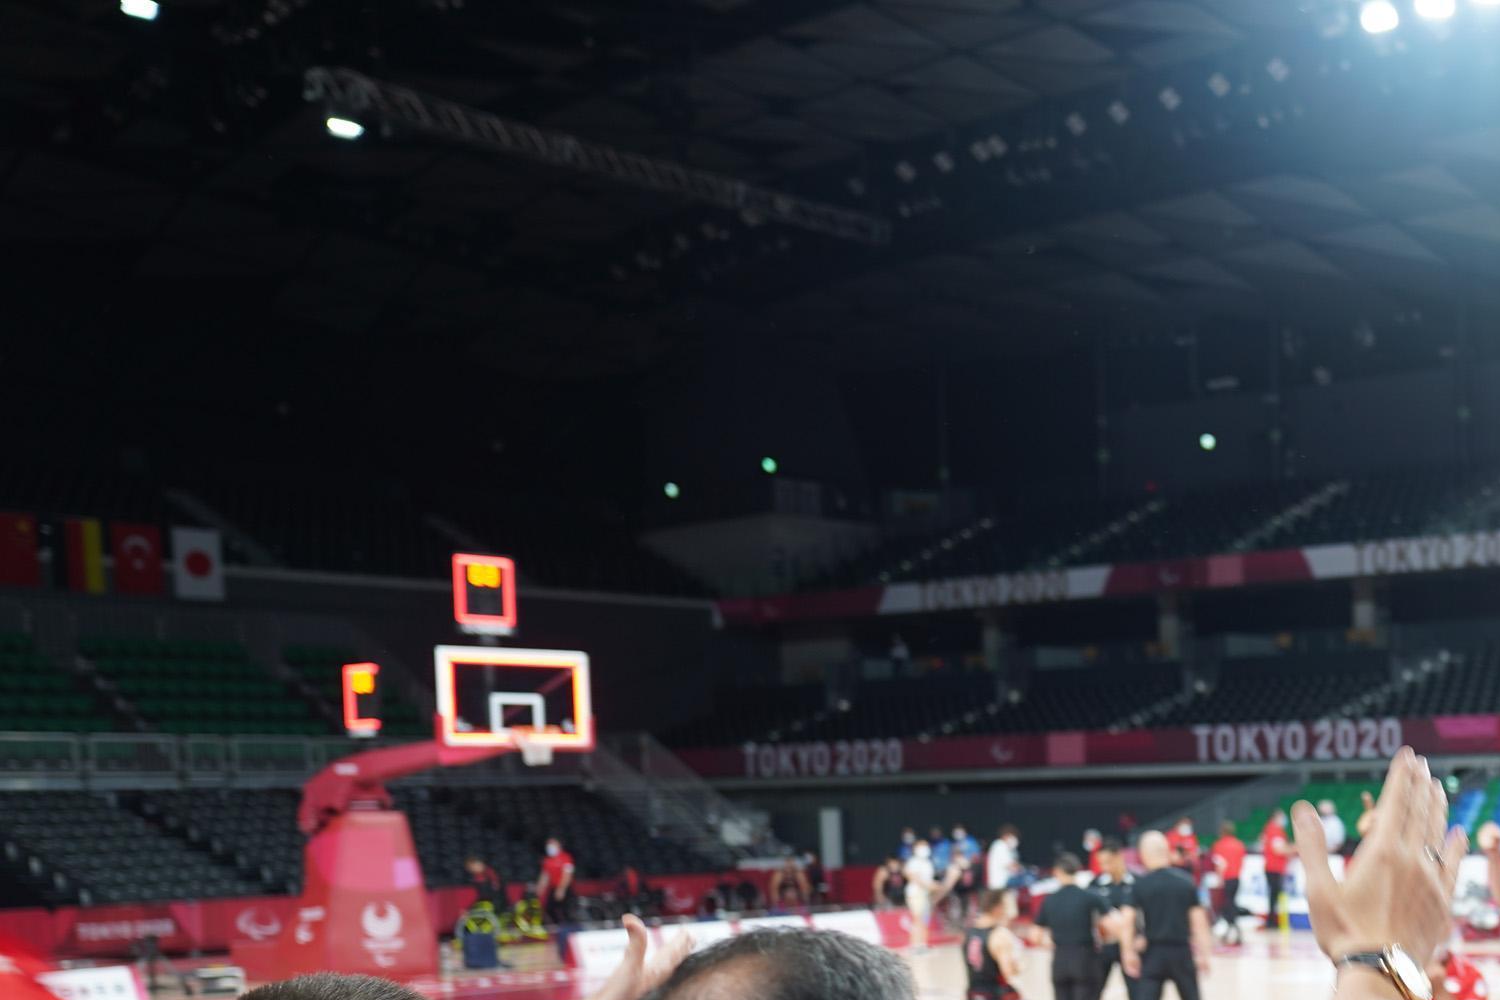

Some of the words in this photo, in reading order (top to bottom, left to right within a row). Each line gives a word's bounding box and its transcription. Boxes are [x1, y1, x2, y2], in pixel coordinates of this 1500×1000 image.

[744, 740, 831, 779] TOKYO
[836, 736, 903, 775] 2020
[1193, 720, 1307, 763] TOKYO
[1311, 715, 1403, 760] 2020
